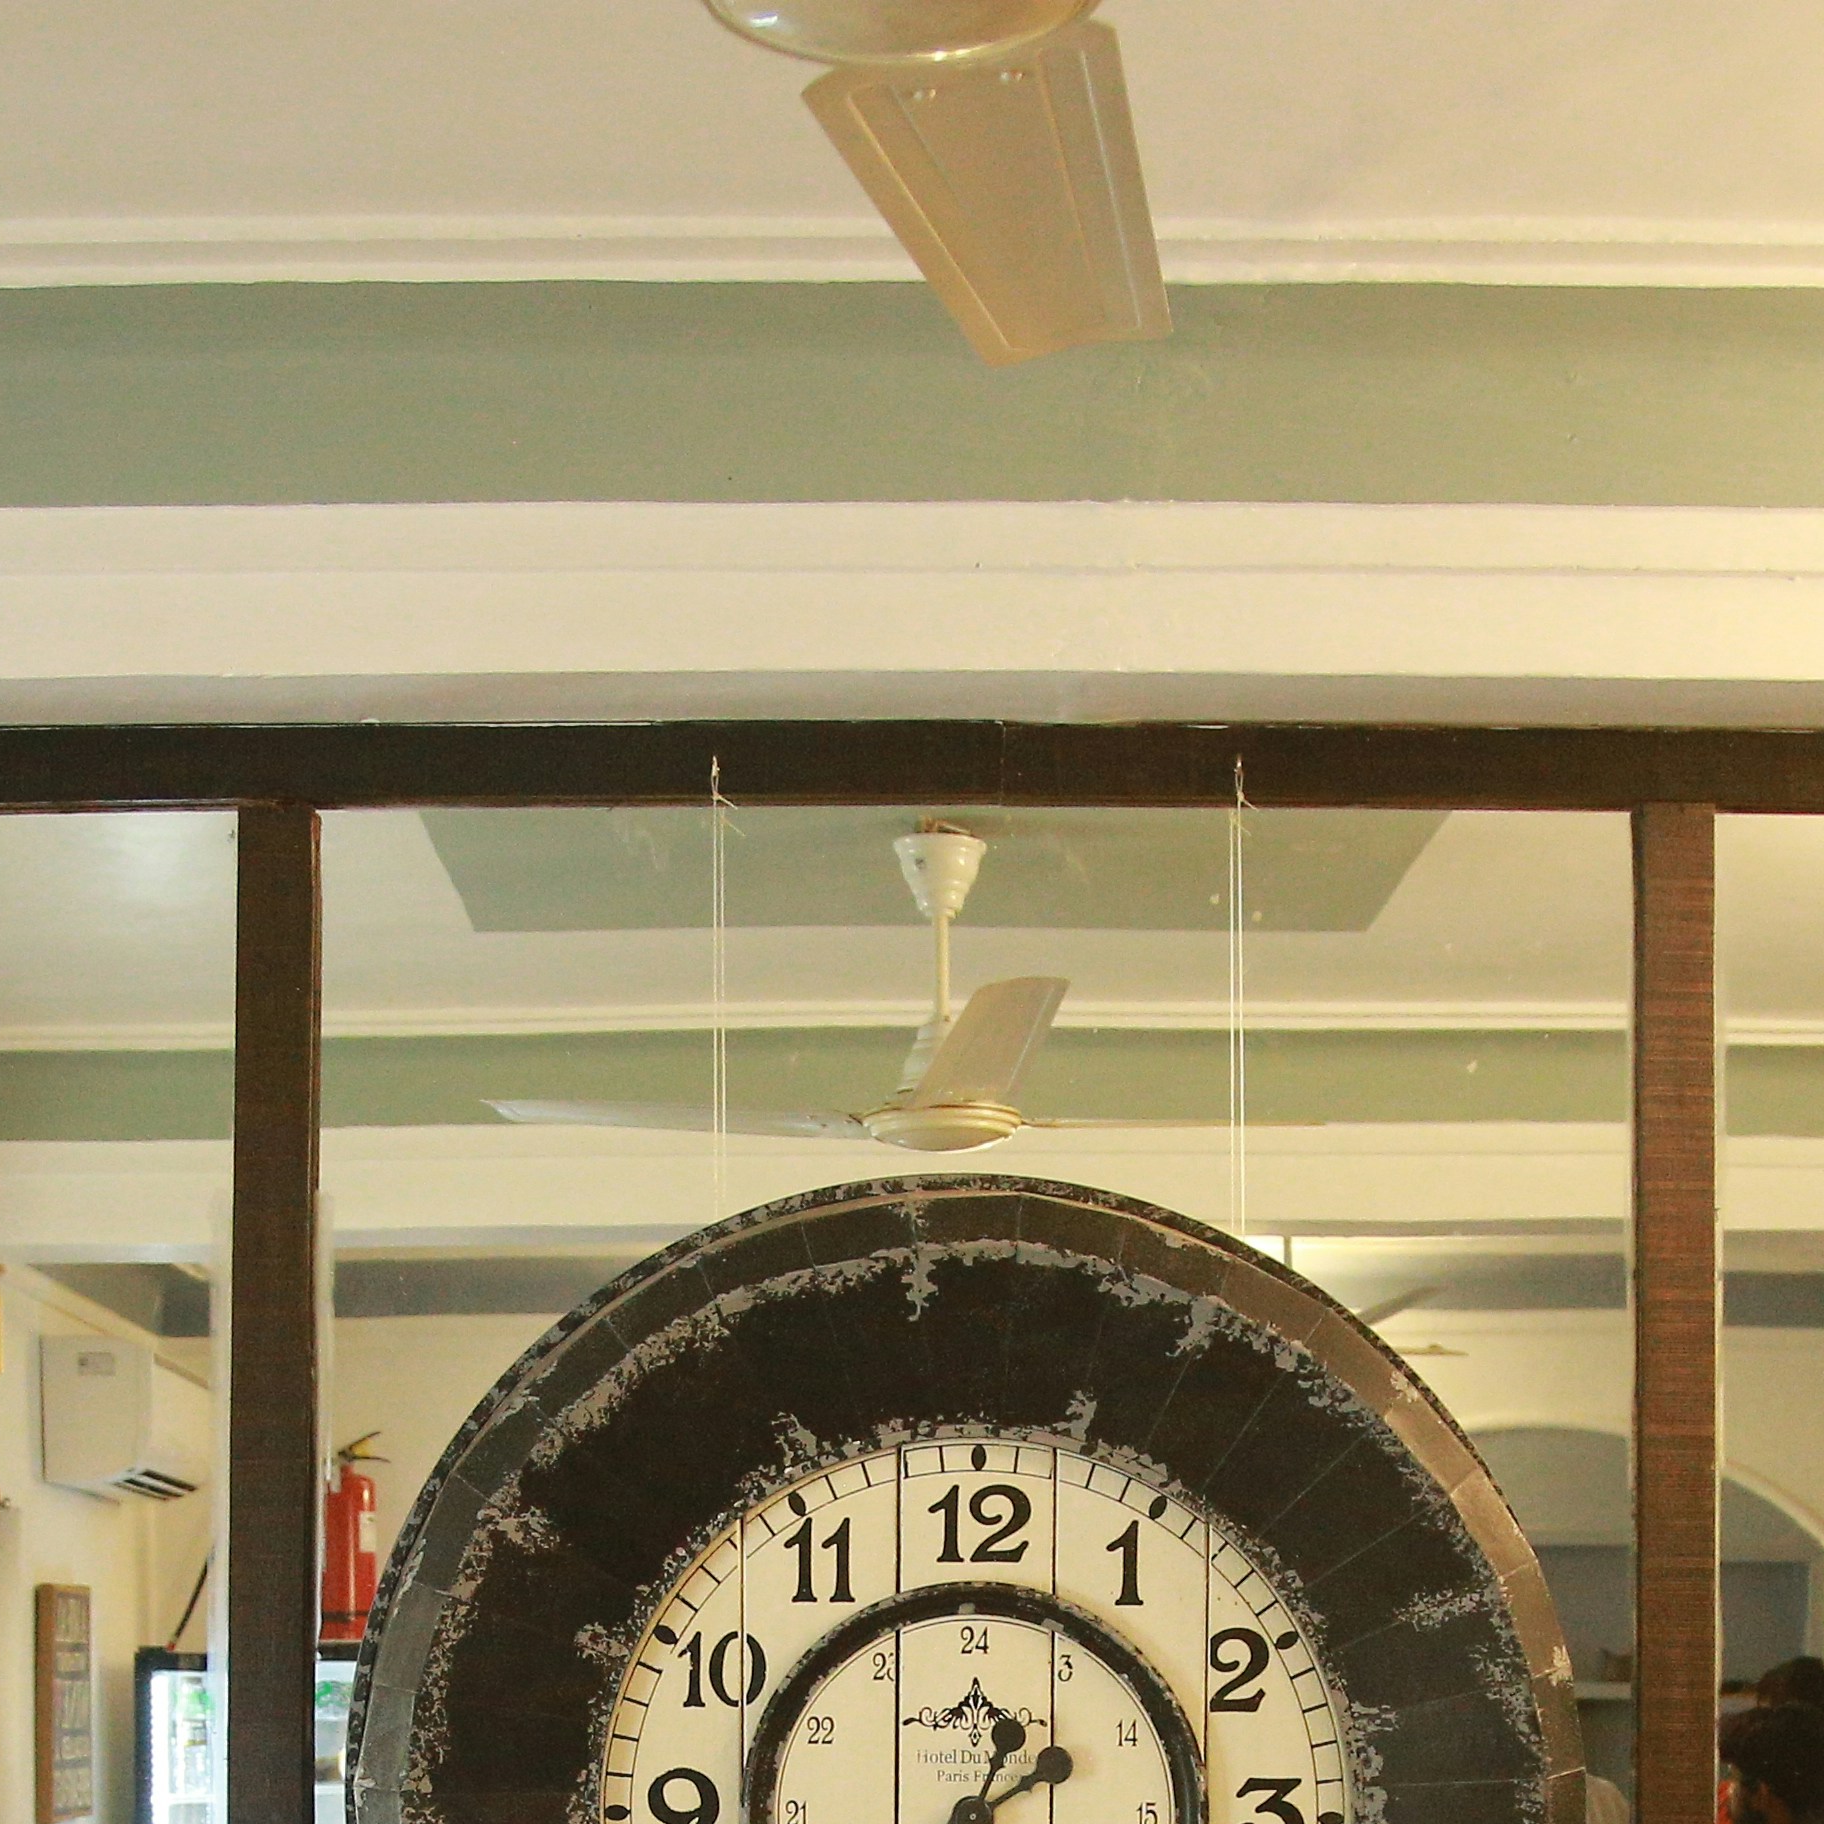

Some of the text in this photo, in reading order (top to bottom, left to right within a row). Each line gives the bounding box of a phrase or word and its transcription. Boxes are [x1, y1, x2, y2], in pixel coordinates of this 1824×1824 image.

[927, 1484, 1032, 1564] 12
[784, 1517, 855, 1603] 11
[1106, 1519, 1145, 1606] 1
[960, 1625, 990, 1655] 24
[679, 1630, 767, 1708] 10
[1209, 1627, 1269, 1713] 2
[807, 1717, 835, 1745] 22
[960, 1748, 982, 1765] Du
[1116, 1719, 1139, 1748] 14
[936, 1769, 970, 1783] Paris
